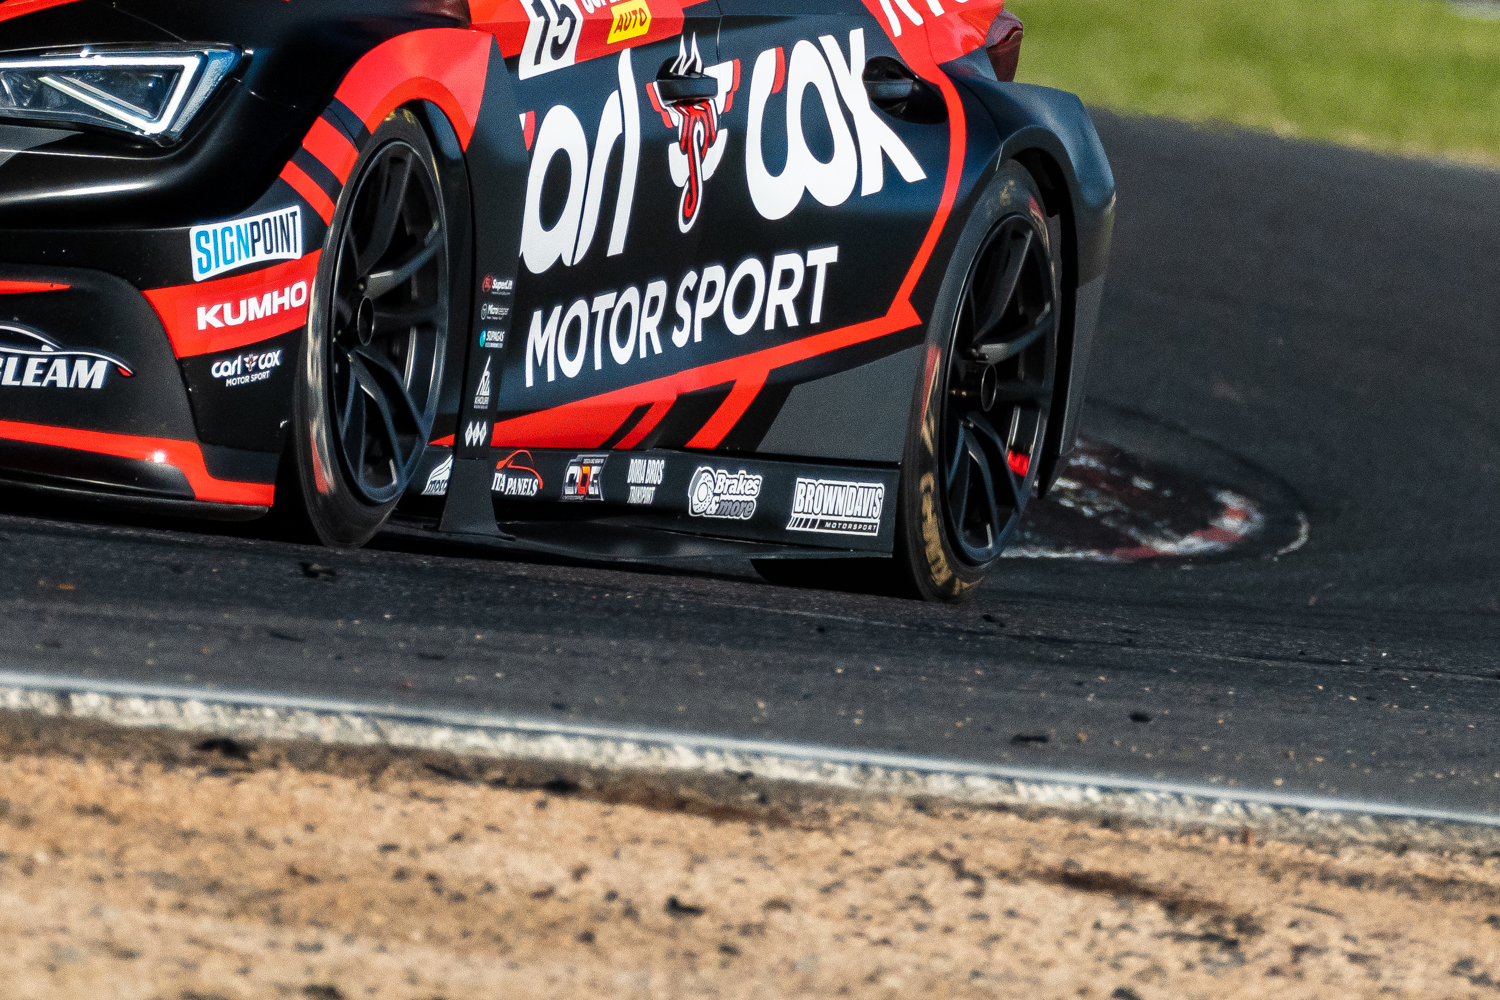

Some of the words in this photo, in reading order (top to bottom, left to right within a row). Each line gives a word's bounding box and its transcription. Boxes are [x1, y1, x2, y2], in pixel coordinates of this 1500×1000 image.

[613, 7, 648, 34] AUTO
[519, 48, 641, 274] arl
[746, 28, 927, 220] cox
[195, 211, 298, 274] SIGNPOINT
[197, 281, 307, 330] KUMHO
[526, 280, 667, 388] MOTOR
[671, 245, 839, 348] SPORT
[211, 354, 242, 378] carl
[258, 350, 281, 370] cox
[225, 375, 250, 387] MOTOR
[250, 371, 270, 383] SPORT
[645, 459, 665, 485] BROS
[714, 471, 760, 496] Brakes
[504, 477, 538, 497] PANELS
[793, 481, 846, 516] BROWN
[844, 486, 882, 519] DAVIS
[825, 521, 877, 531] MOTORSPORT
